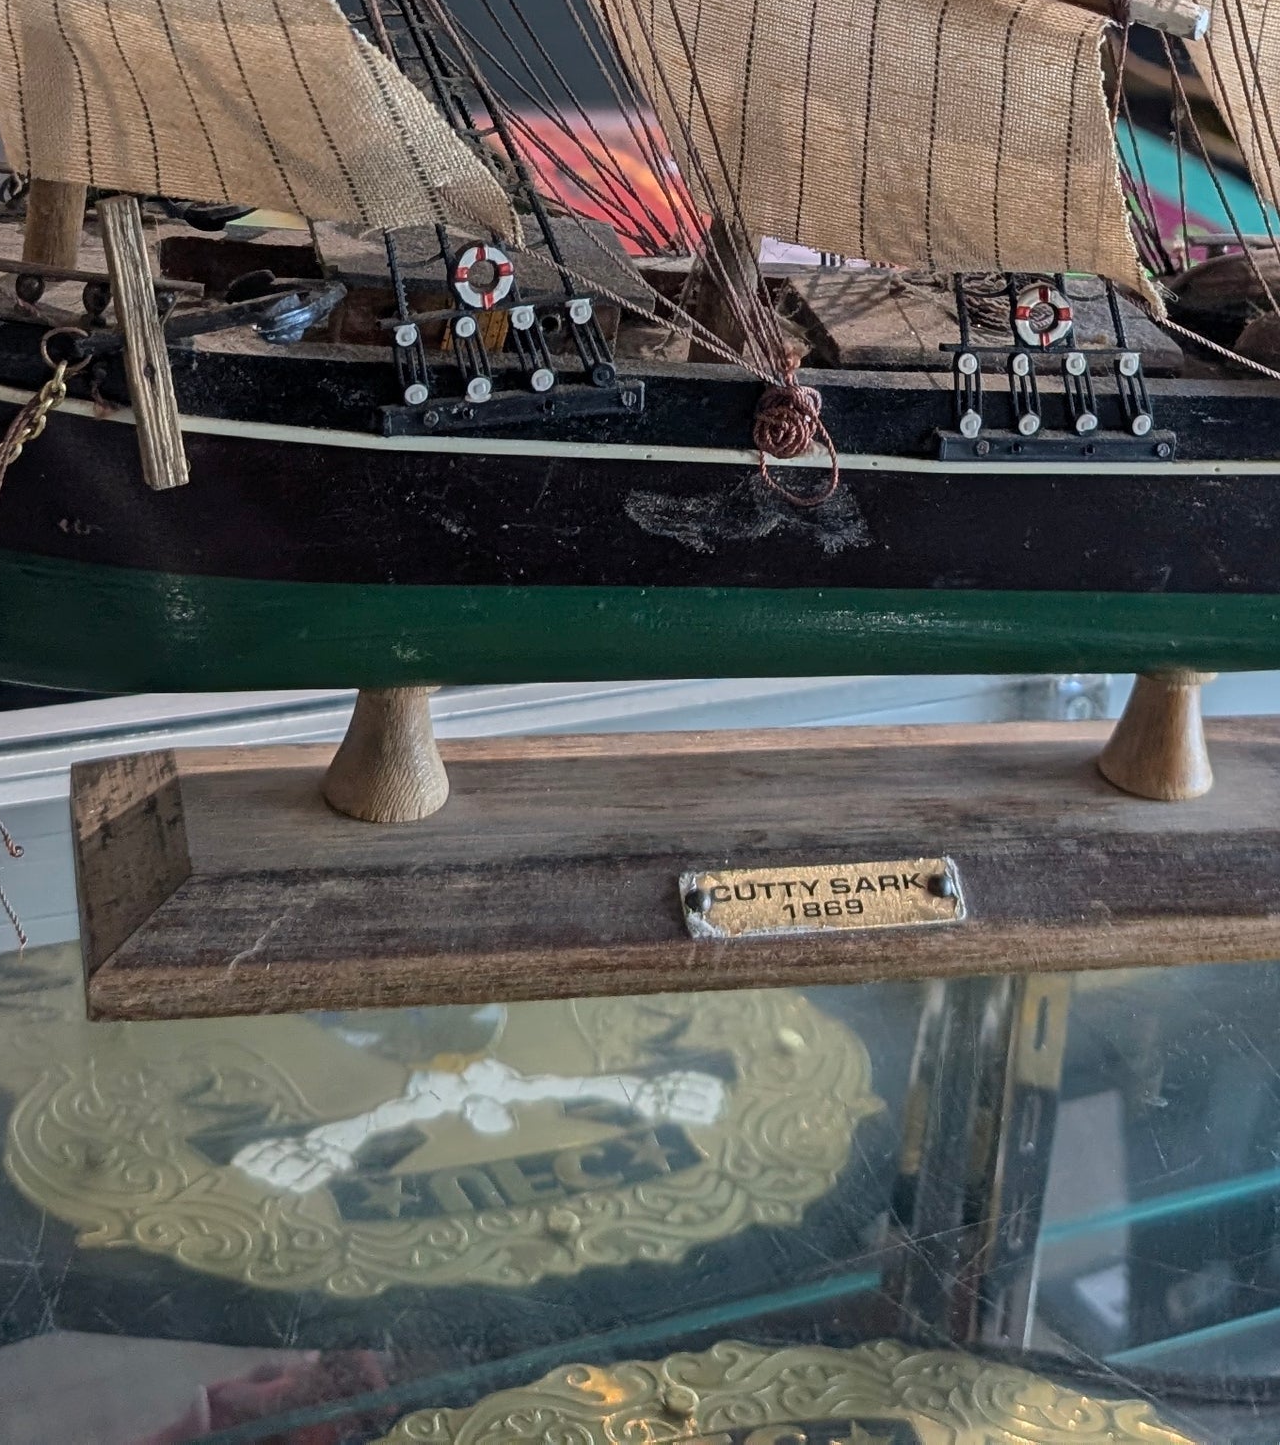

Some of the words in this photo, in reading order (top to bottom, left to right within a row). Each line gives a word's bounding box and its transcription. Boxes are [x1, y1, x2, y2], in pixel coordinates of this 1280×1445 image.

[709, 879, 820, 904] CUTTY
[830, 872, 926, 895] SARK
[781, 898, 864, 920] 1869
